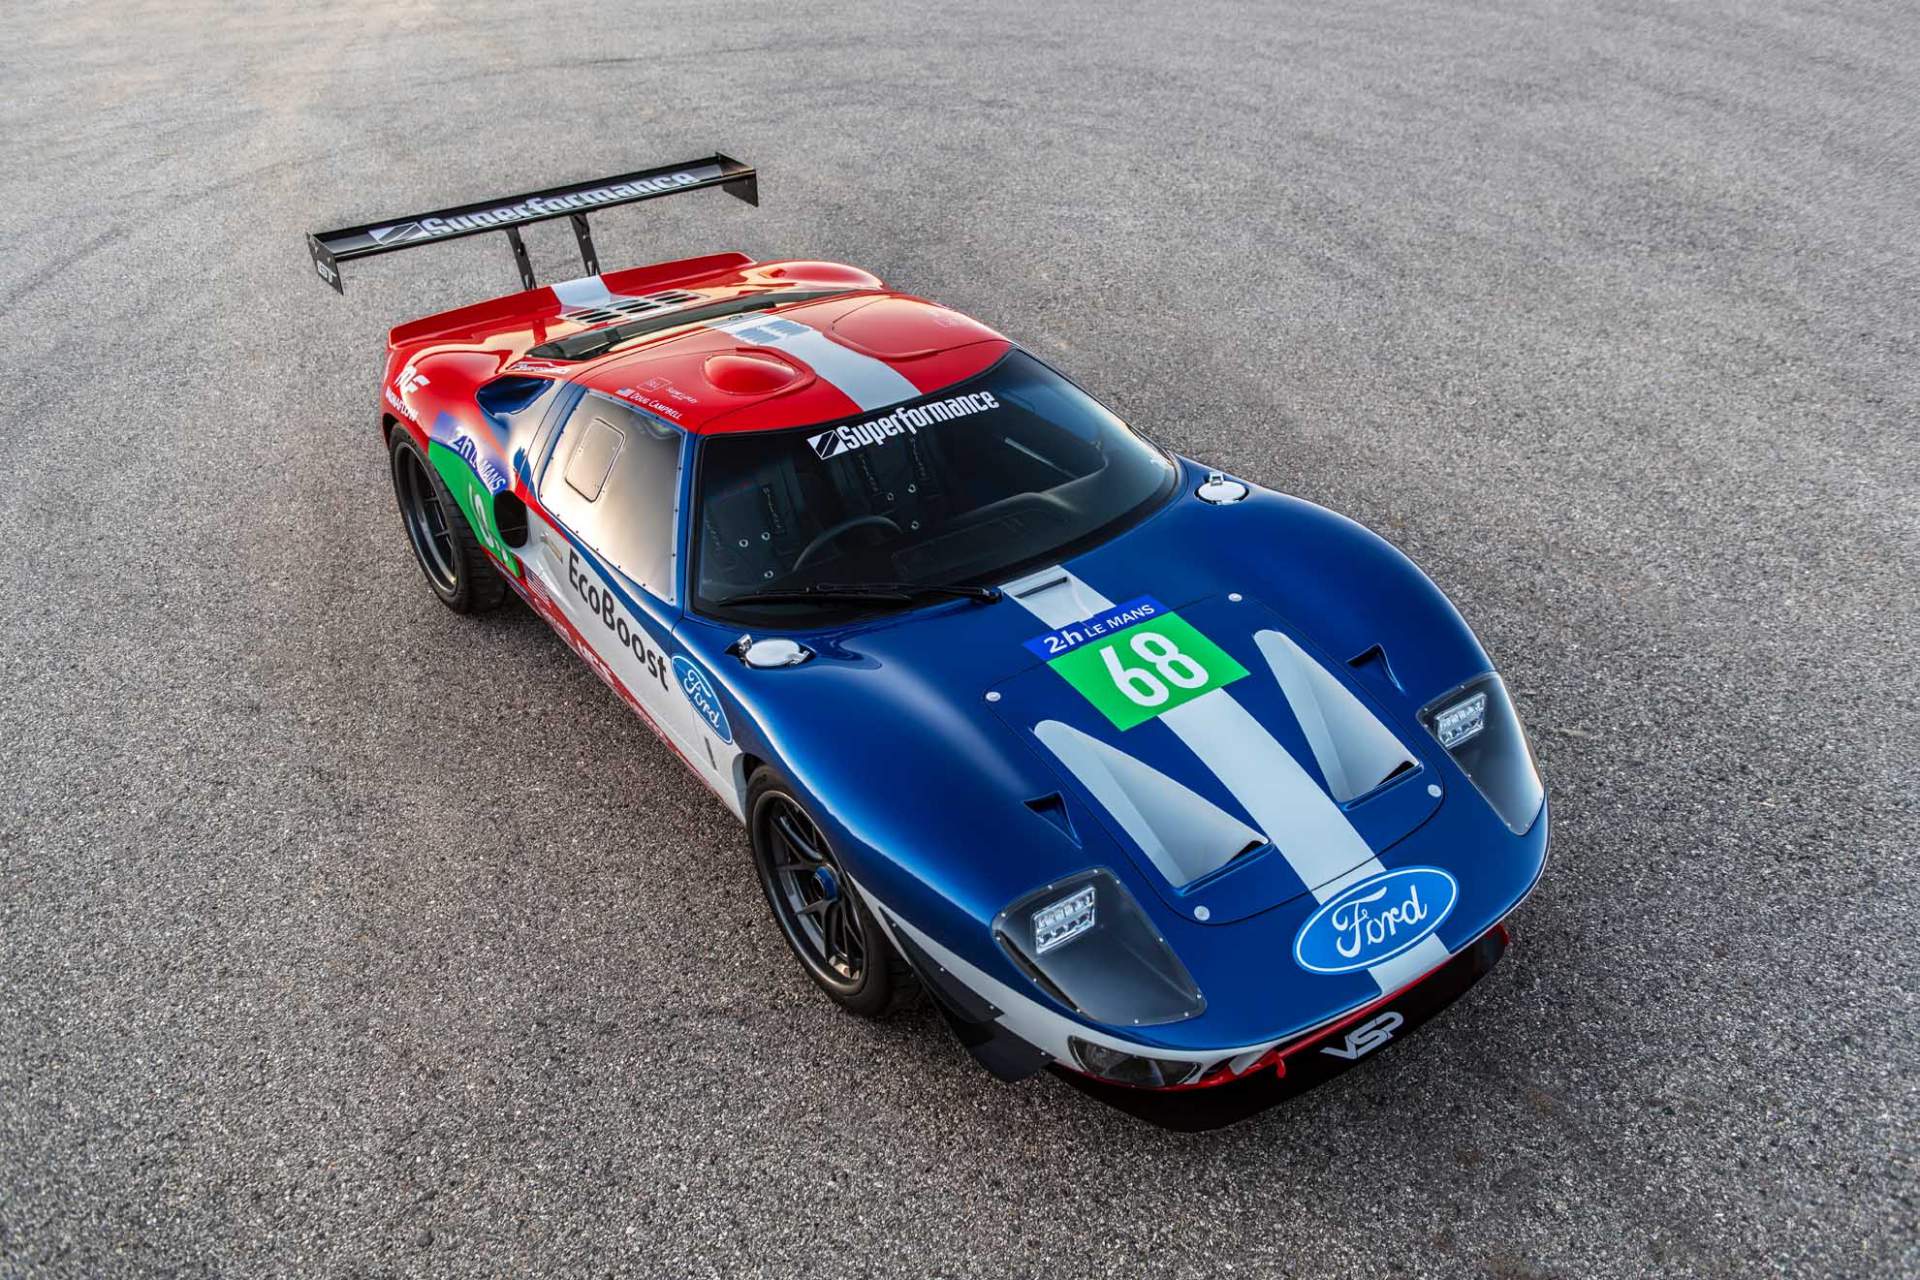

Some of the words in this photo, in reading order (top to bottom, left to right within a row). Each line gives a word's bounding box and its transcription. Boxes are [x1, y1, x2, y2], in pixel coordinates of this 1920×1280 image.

[421, 171, 700, 237] Superformance
[836, 390, 1000, 452] Superformance
[568, 547, 670, 692] EcoBoost
[1084, 622, 1107, 638] LE
[1106, 604, 1156, 630] MANS
[684, 668, 720, 729] Ford
[1099, 632, 1209, 708] 68
[1332, 884, 1428, 958] Ford
[1320, 1010, 1404, 1060] VSP
